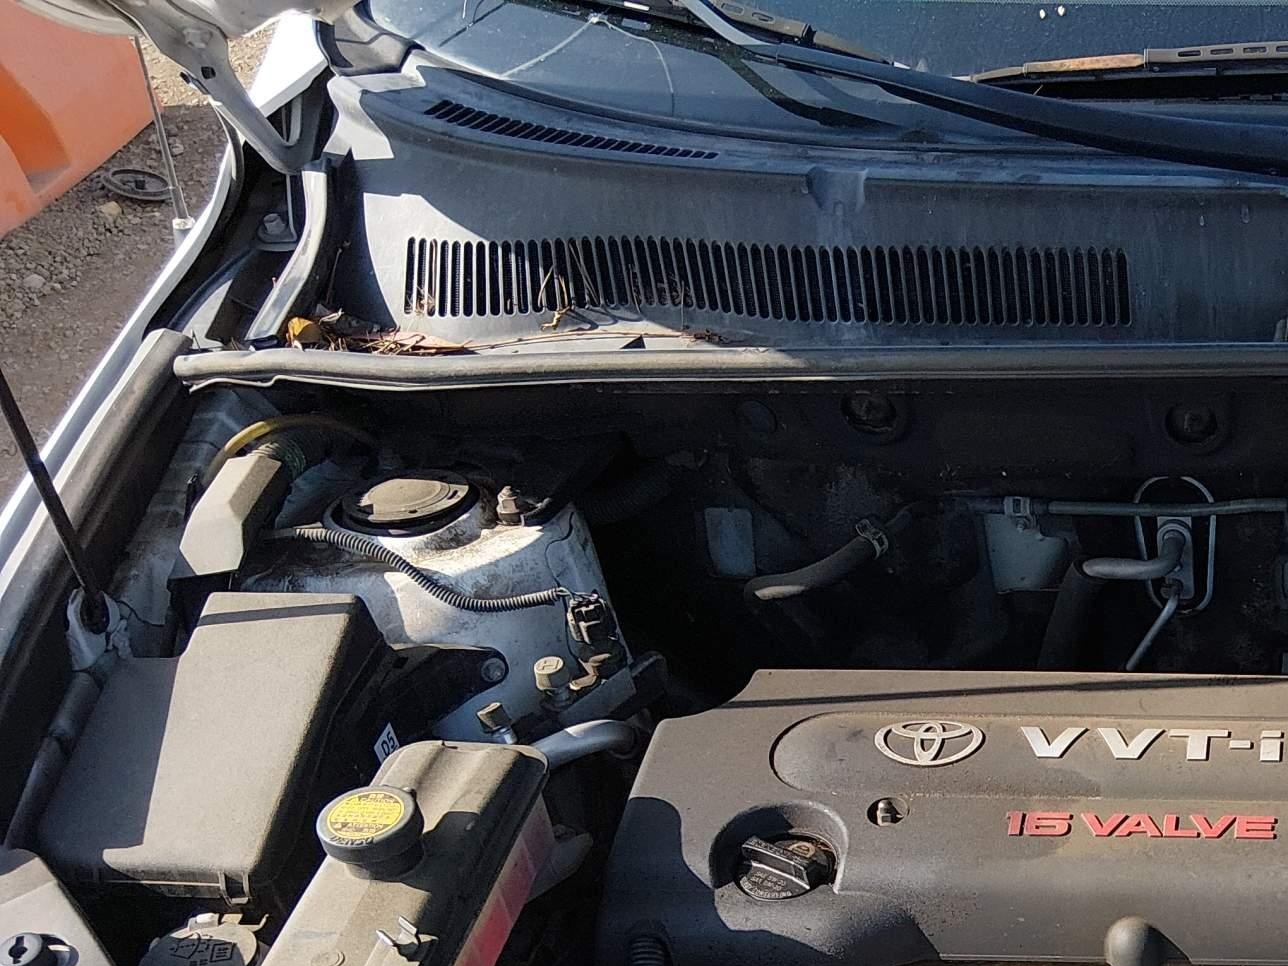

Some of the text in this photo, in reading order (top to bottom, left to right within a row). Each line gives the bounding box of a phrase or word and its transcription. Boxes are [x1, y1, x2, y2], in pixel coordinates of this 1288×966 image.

[1021, 726, 1283, 761] VVT-i
[1007, 812, 1277, 839] 16 VALVE
